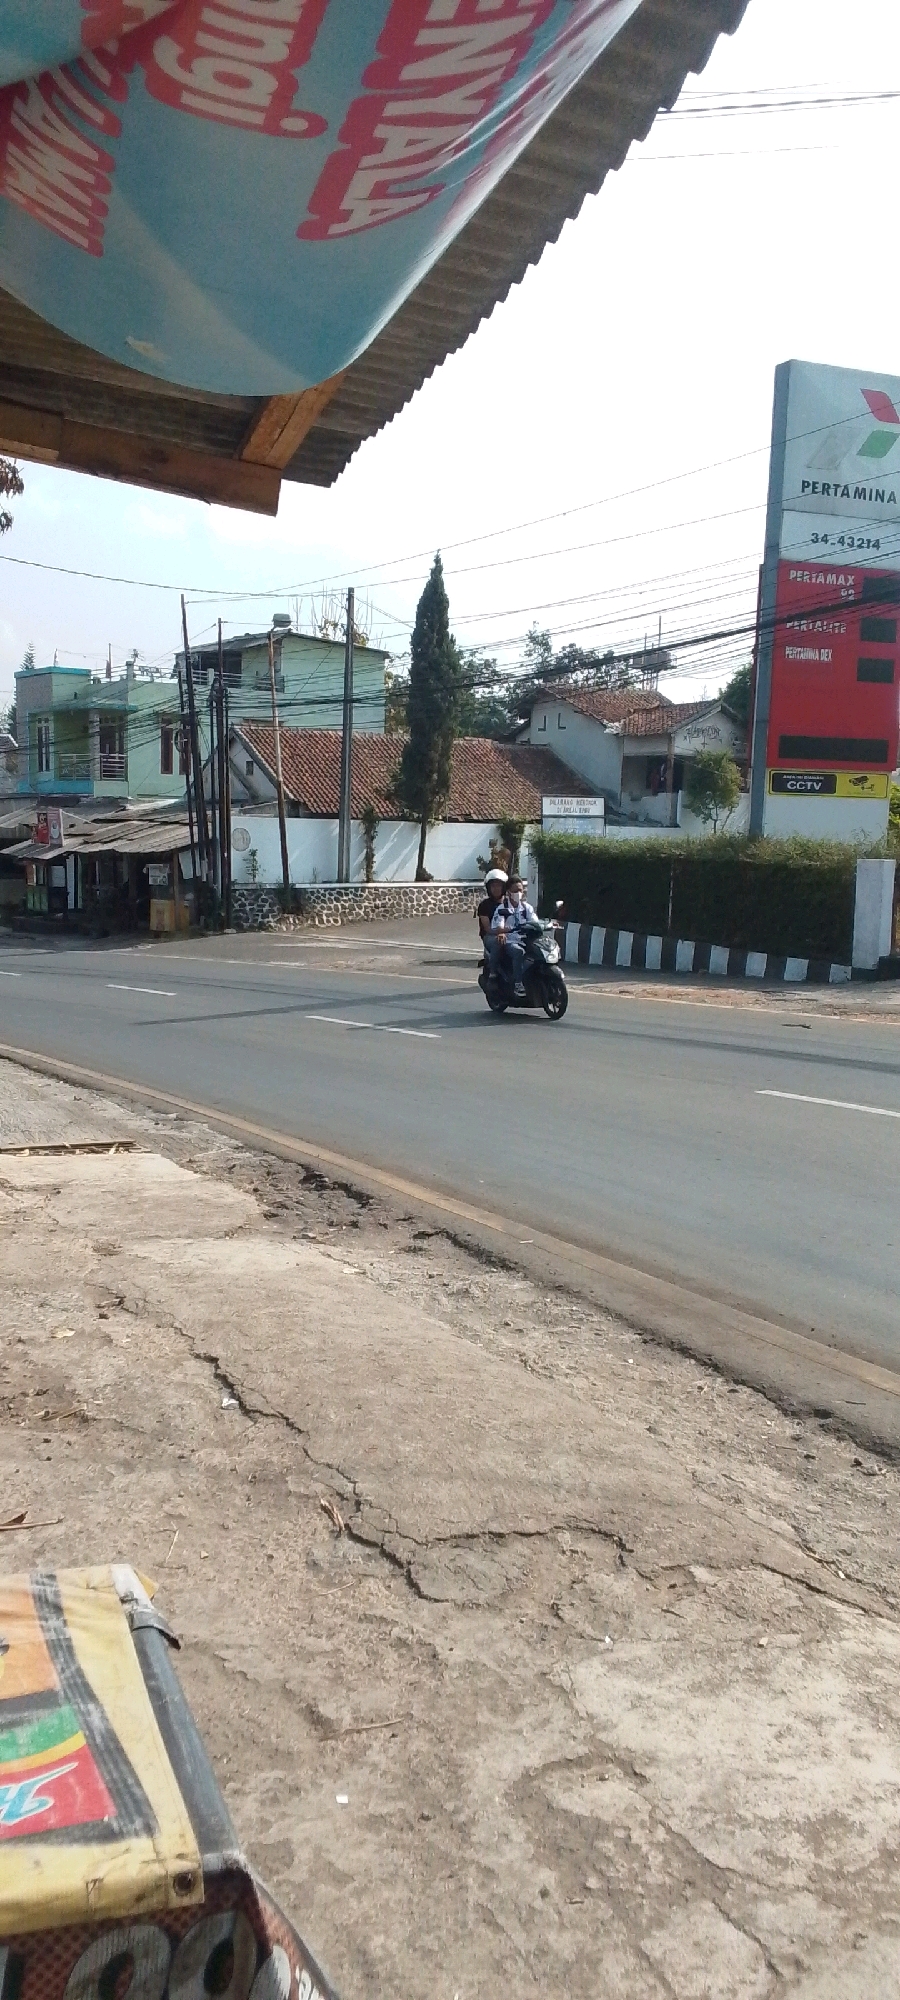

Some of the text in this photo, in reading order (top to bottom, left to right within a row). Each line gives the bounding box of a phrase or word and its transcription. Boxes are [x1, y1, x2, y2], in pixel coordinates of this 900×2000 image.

[801, 480, 897, 504] PERTAMINA
[789, 570, 855, 586] PERTAMAX
[785, 645, 833, 662] PERTAMINA DEX
[786, 780, 822, 790] CCTV
